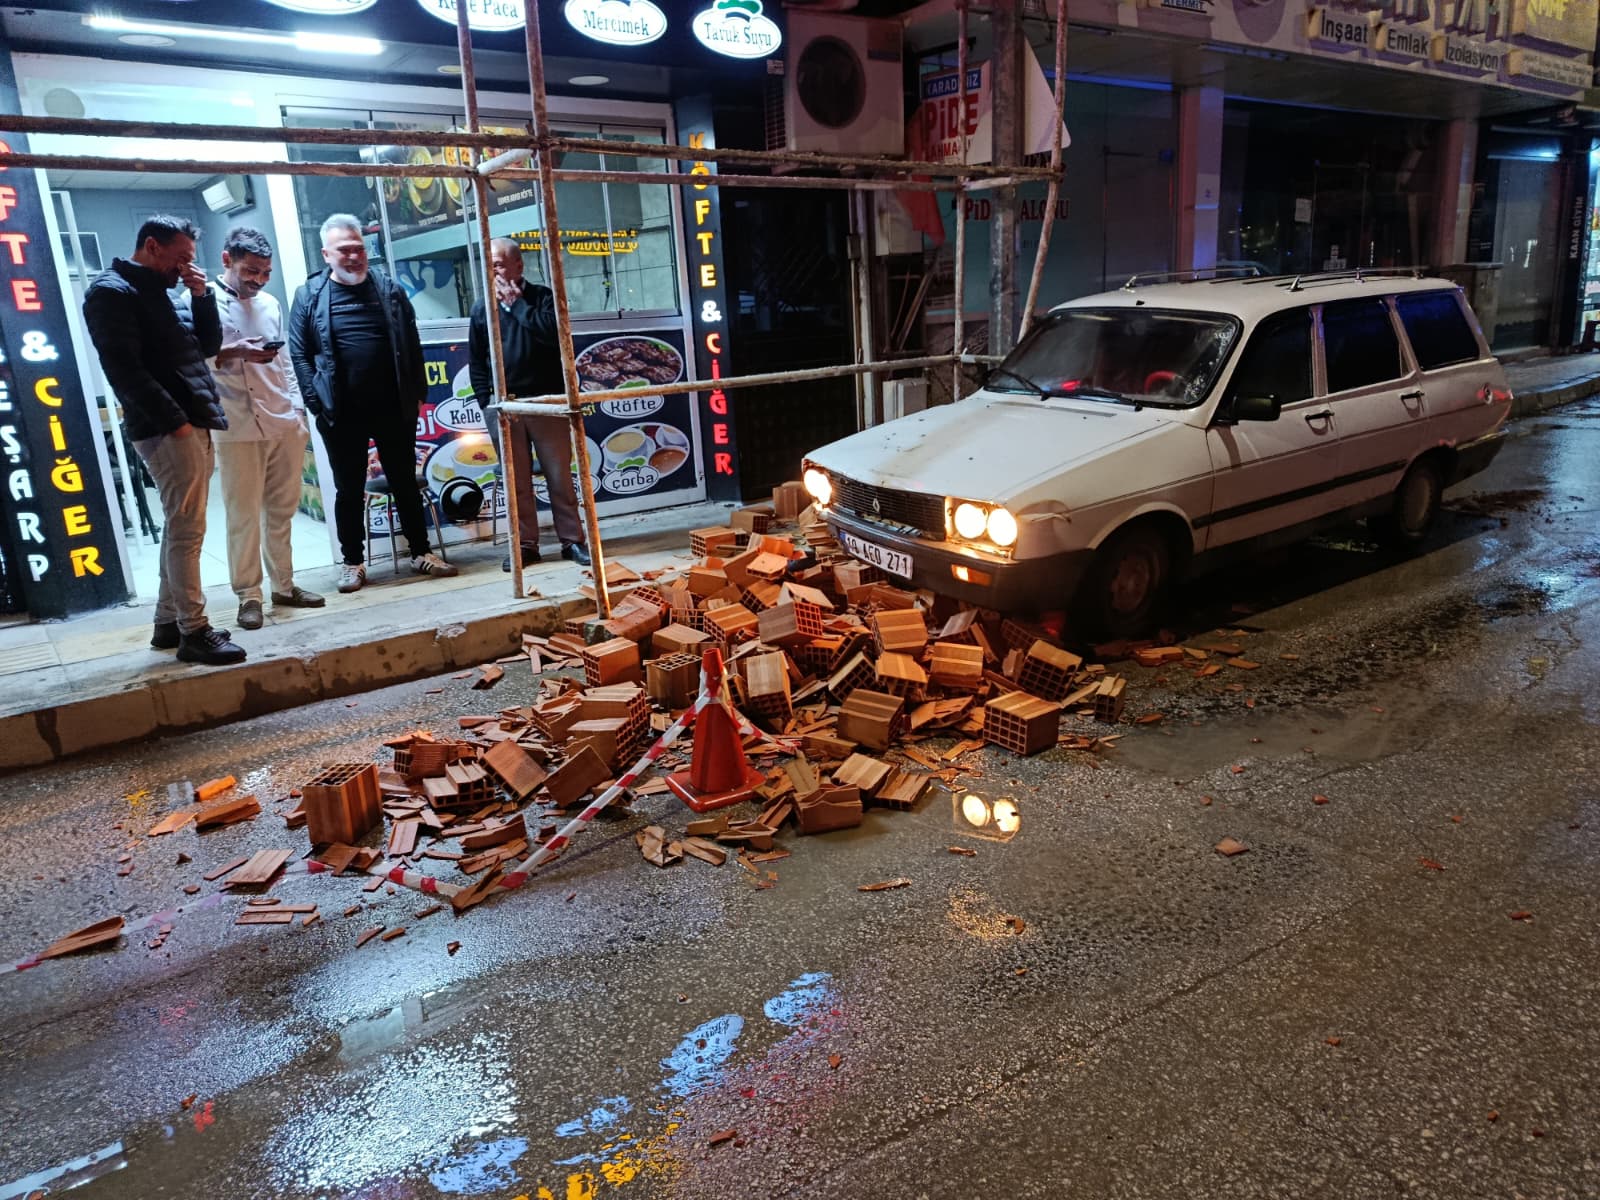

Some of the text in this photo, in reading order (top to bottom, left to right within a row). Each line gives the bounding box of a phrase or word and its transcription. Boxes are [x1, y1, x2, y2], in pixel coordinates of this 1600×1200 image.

[439, 0, 477, 13] Kee
[583, 10, 650, 36] Mercimek
[1321, 9, 1368, 43] İnşaat
[1388, 31, 1428, 56] Emlak
[704, 22, 772, 49] Tavuk Suyu
[701, 300, 722, 322] &
[20, 330, 59, 362] &
[450, 408, 482, 425] Kelle
[611, 399, 656, 414] Köfte
[34, 377, 104, 578] CİĞER
[612, 470, 655, 490] çorba
[887, 552, 908, 575] 271
